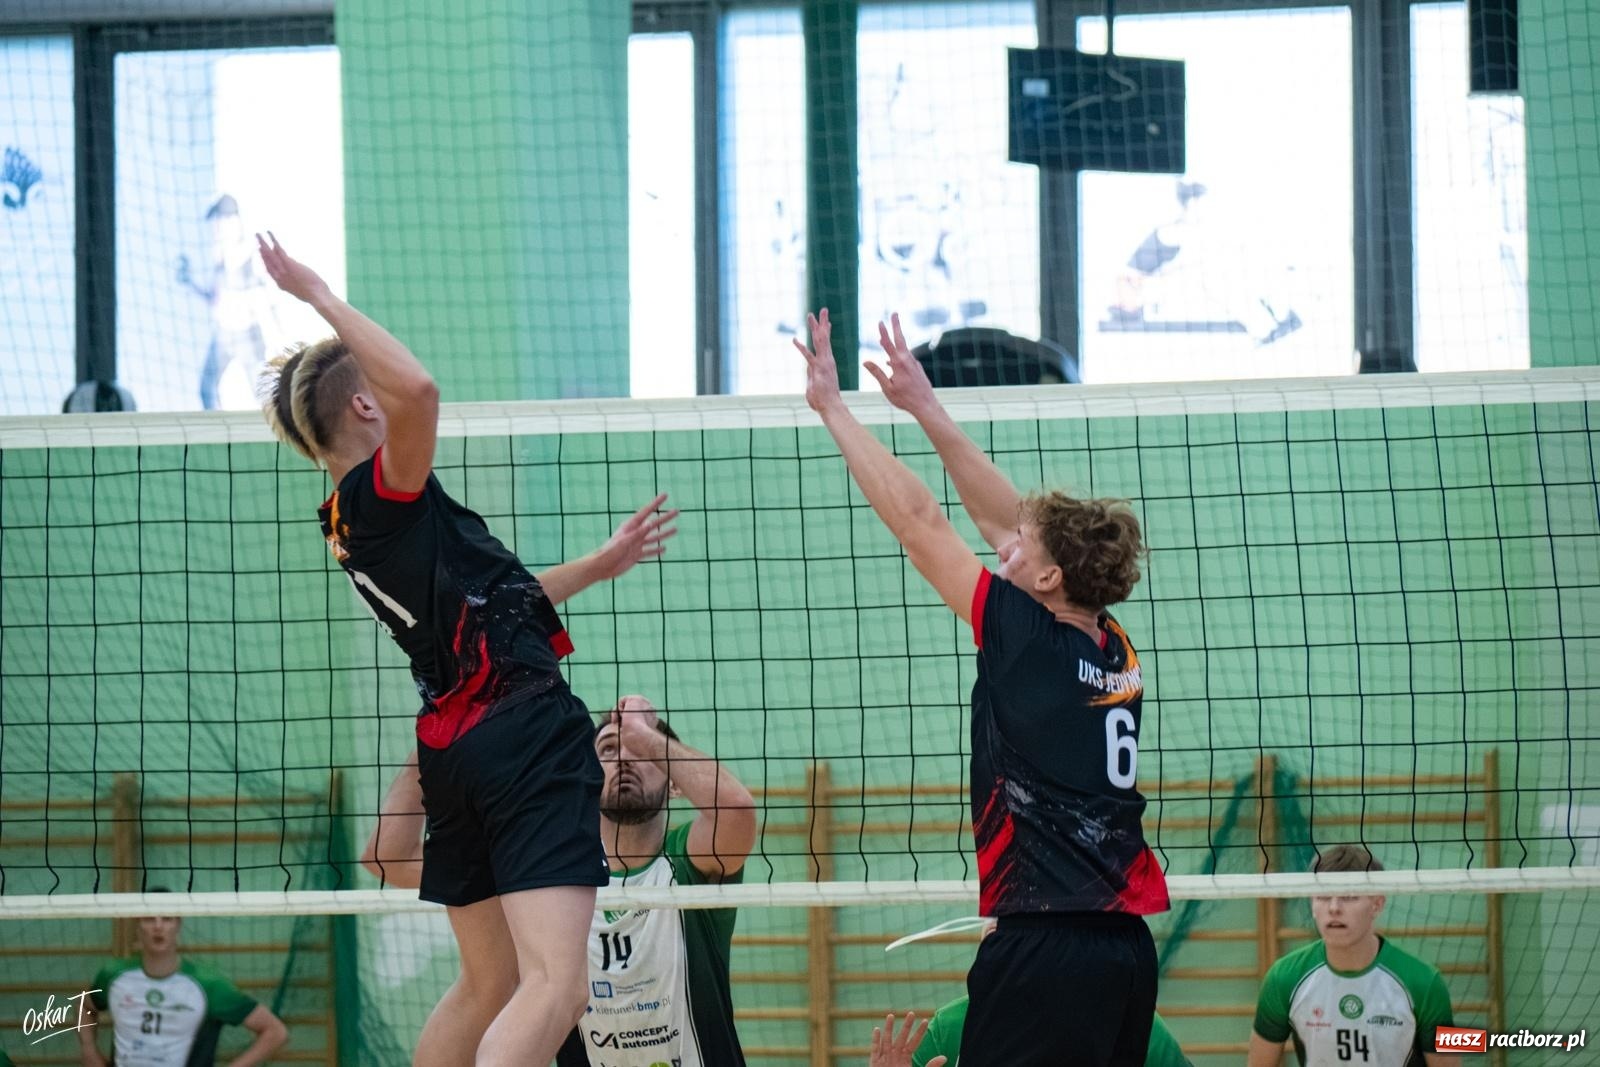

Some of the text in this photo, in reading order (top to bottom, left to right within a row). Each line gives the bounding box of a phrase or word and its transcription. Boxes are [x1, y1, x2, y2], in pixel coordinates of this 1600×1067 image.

[1078, 658, 1104, 690] UKS
[1105, 707, 1138, 790] 6
[598, 932, 632, 971] 14
[595, 995, 671, 1015] kierunekbmp.pl
[141, 1010, 163, 1035] 21
[618, 1024, 669, 1040] CONCEPT
[622, 1028, 680, 1049] automatic
[1336, 1029, 1369, 1062] 54
